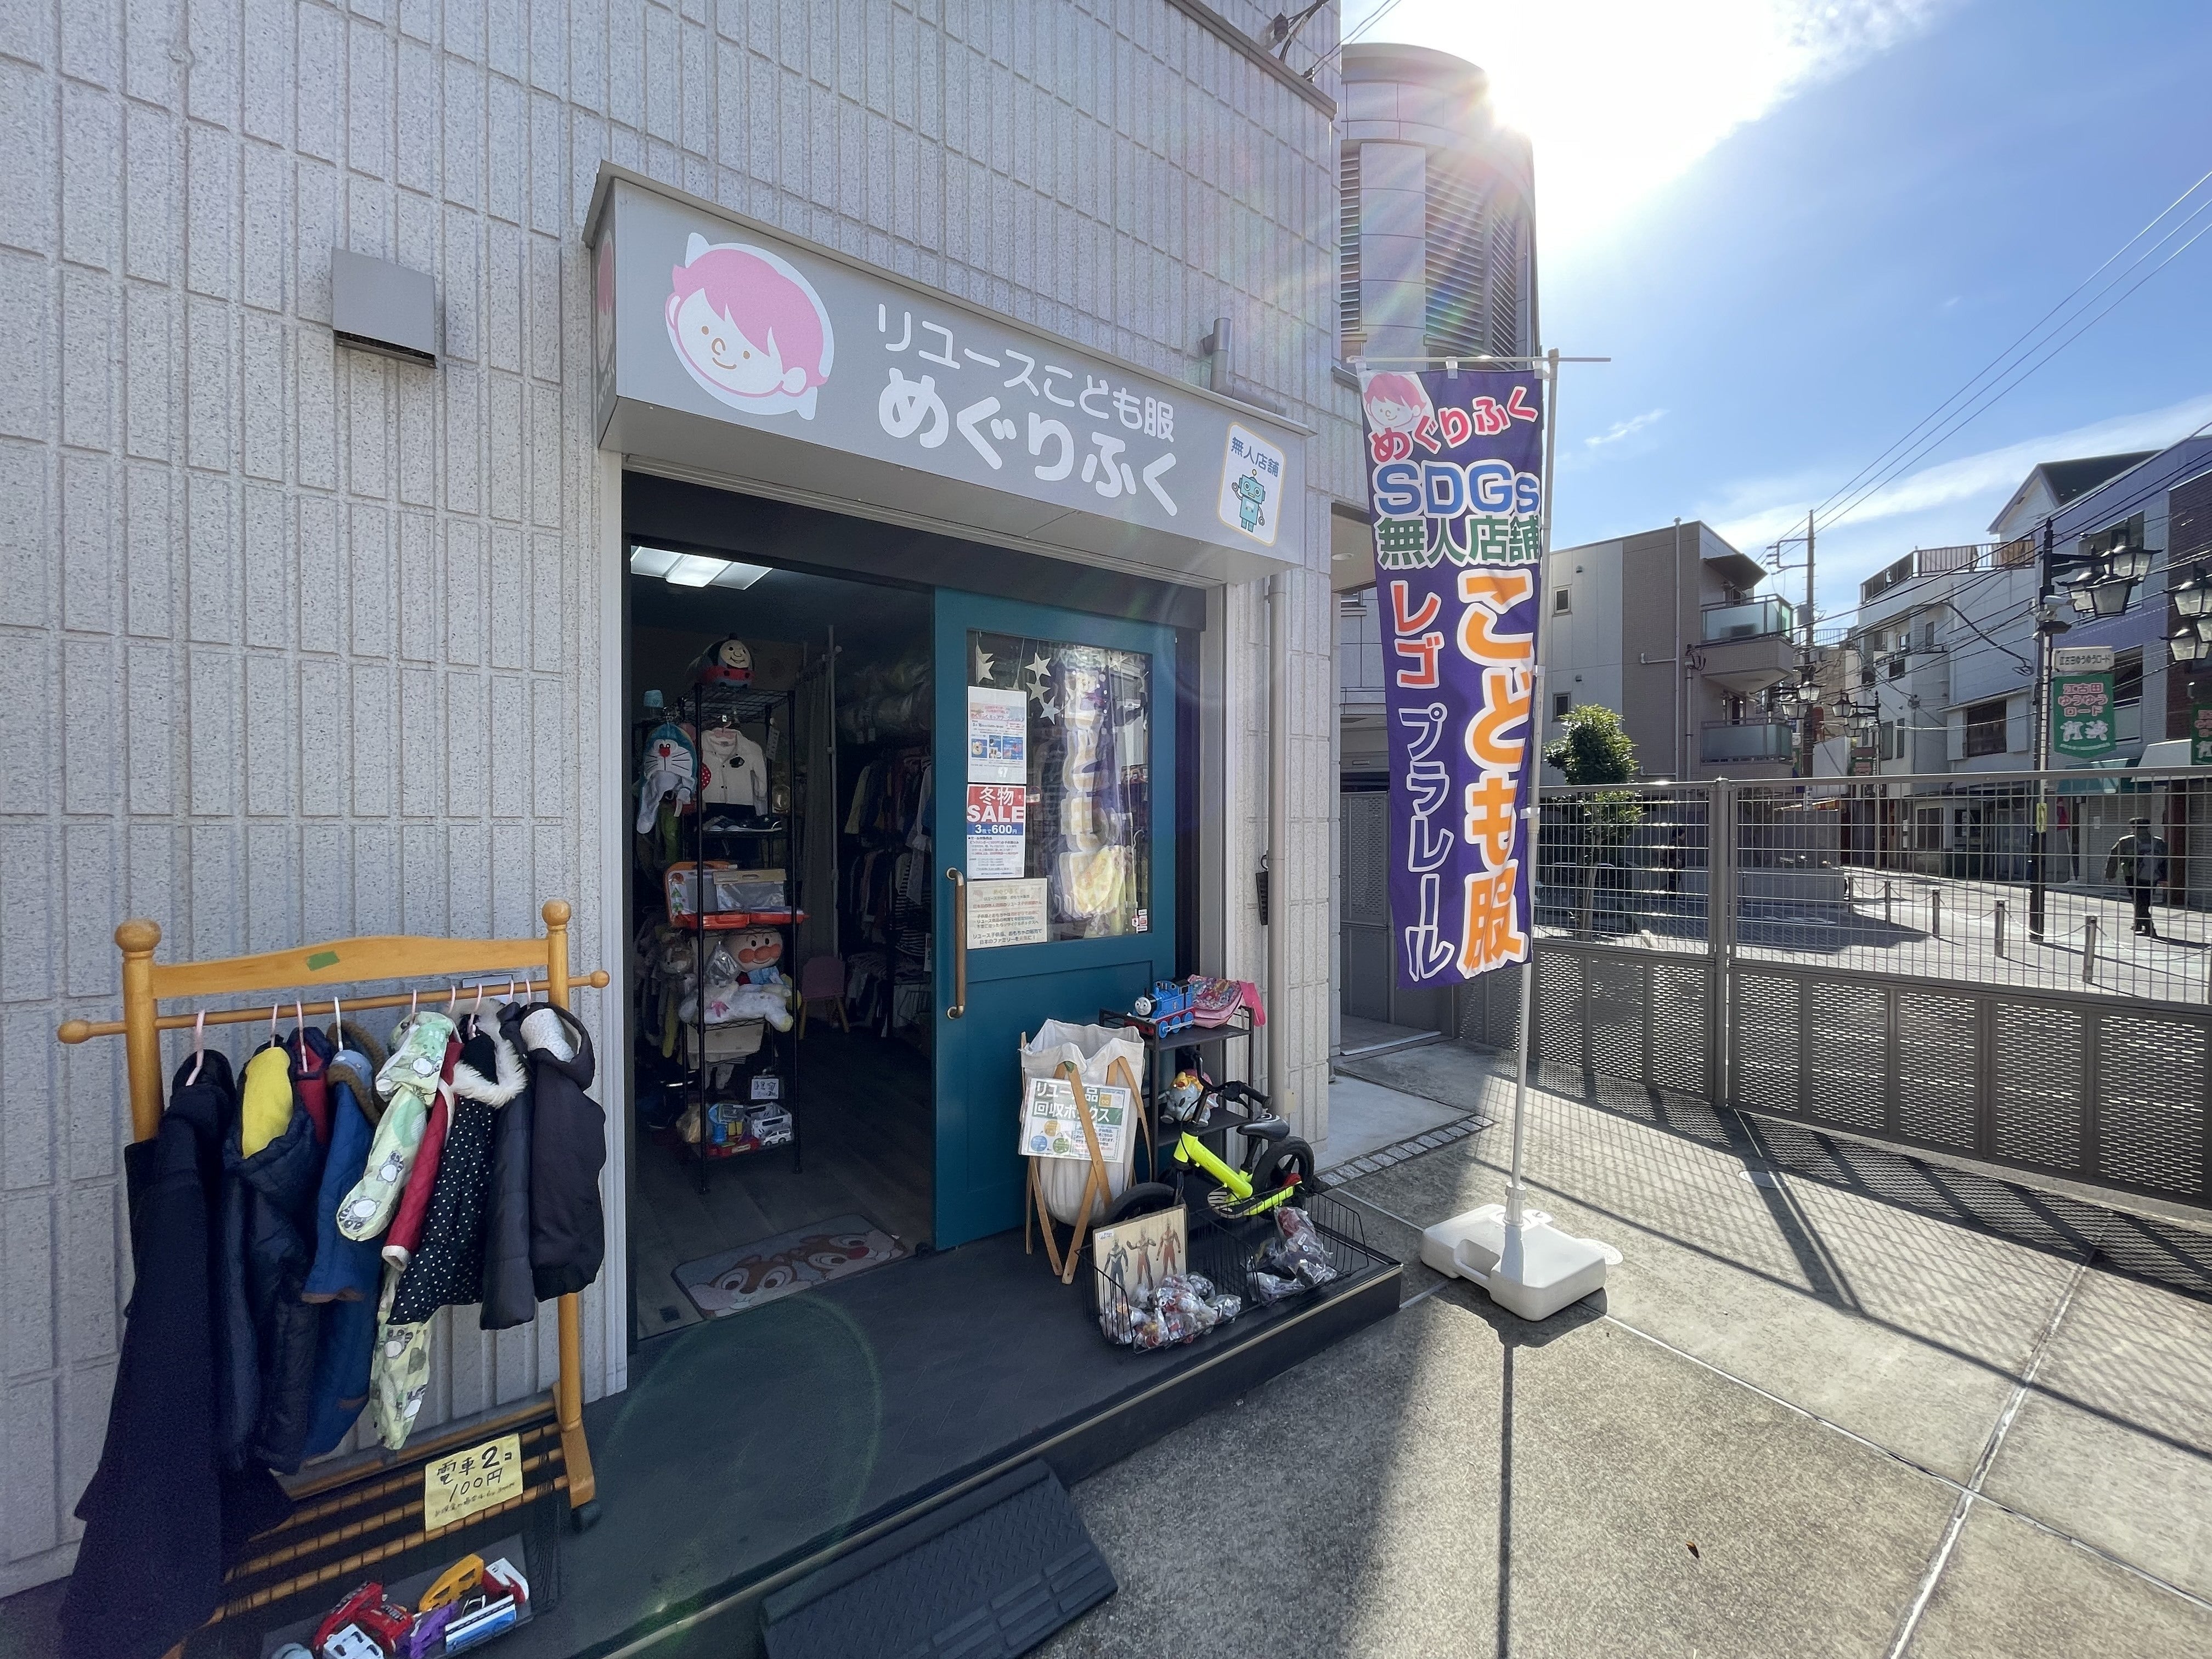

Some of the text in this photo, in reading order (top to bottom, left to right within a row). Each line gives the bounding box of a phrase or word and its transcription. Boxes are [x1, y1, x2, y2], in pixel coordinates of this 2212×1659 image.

[878, 303, 1175, 442] リユースこども服
[878, 368, 1178, 516] めぐりふく
[1369, 386, 1538, 463] めぐりふく
[1231, 437, 1279, 477] 無人店舗
[1373, 460, 1541, 518] SDGs
[1375, 515, 1541, 569] 無人店舗
[2064, 706, 2103, 717] ロード
[979, 786, 1014, 805] 冬物
[1391, 580, 1454, 981] レゴ プラレール
[1457, 569, 1533, 979] こども服
[967, 805, 1024, 823] SALE
[1033, 1101, 1110, 1123] 回収ボクス
[1037, 1082, 1098, 1102] リユー品
[449, 1468, 503, 1502] 100円
